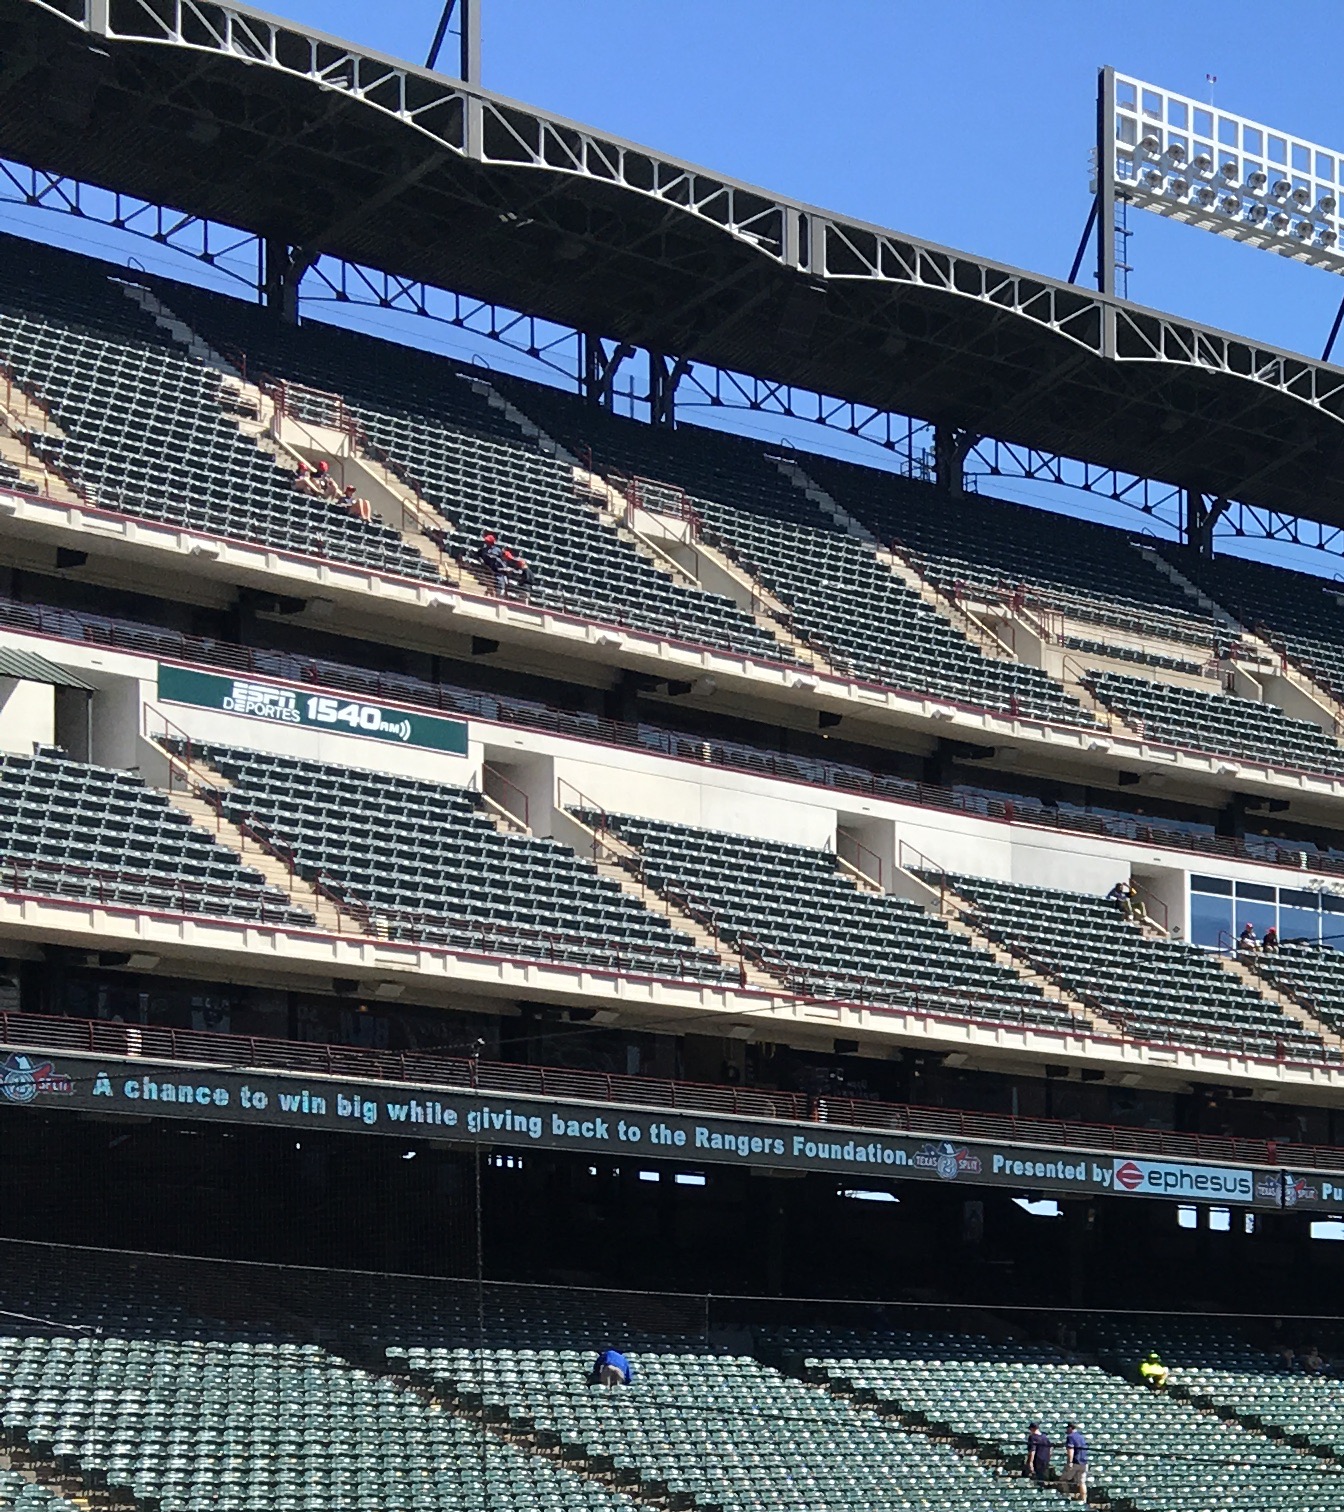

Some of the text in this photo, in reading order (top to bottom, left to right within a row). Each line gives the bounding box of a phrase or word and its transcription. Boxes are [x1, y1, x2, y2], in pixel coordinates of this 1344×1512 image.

[232, 681, 297, 708] ESPN
[223, 696, 301, 723] DEPORTES
[306, 697, 381, 730] 1540
[92, 1072, 914, 1168] A chance to win big while giving back to the Rangers Foundation.
[992, 1154, 1112, 1186] Presented by
[1147, 1169, 1252, 1194] ephesus
